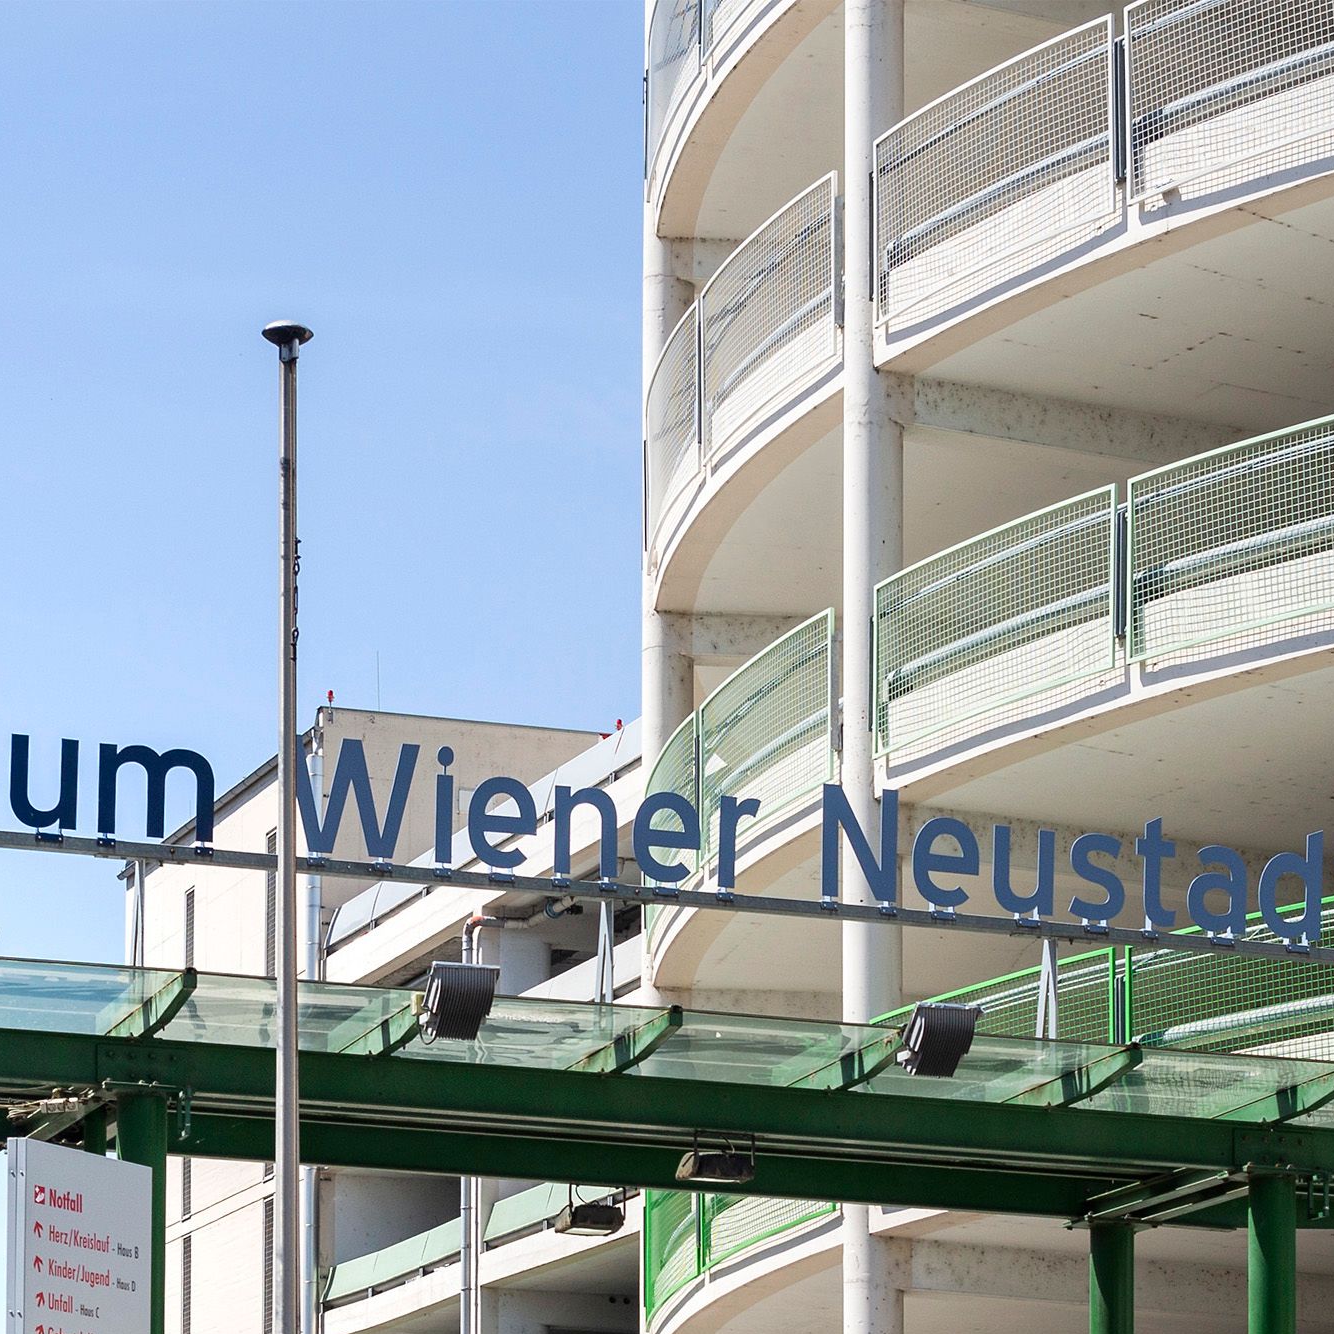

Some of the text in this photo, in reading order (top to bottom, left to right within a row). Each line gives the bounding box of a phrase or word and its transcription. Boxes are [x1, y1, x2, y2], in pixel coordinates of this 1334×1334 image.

[296, 735, 760, 889] Wiener
[49, 1188, 83, 1213] Notfall
[49, 1224, 110, 1254] Herz/Kreislauf
[117, 1243, 132, 1258] Haus
[134, 1246, 139, 1259] B
[48, 1258, 110, 1288] Kinder/Jugend
[116, 1278, 130, 1291] Haus
[132, 1280, 136, 1292] D
[48, 1292, 74, 1314] Unfall
[80, 1304, 94, 1318] Haus
[95, 1306, 100, 1319] C
